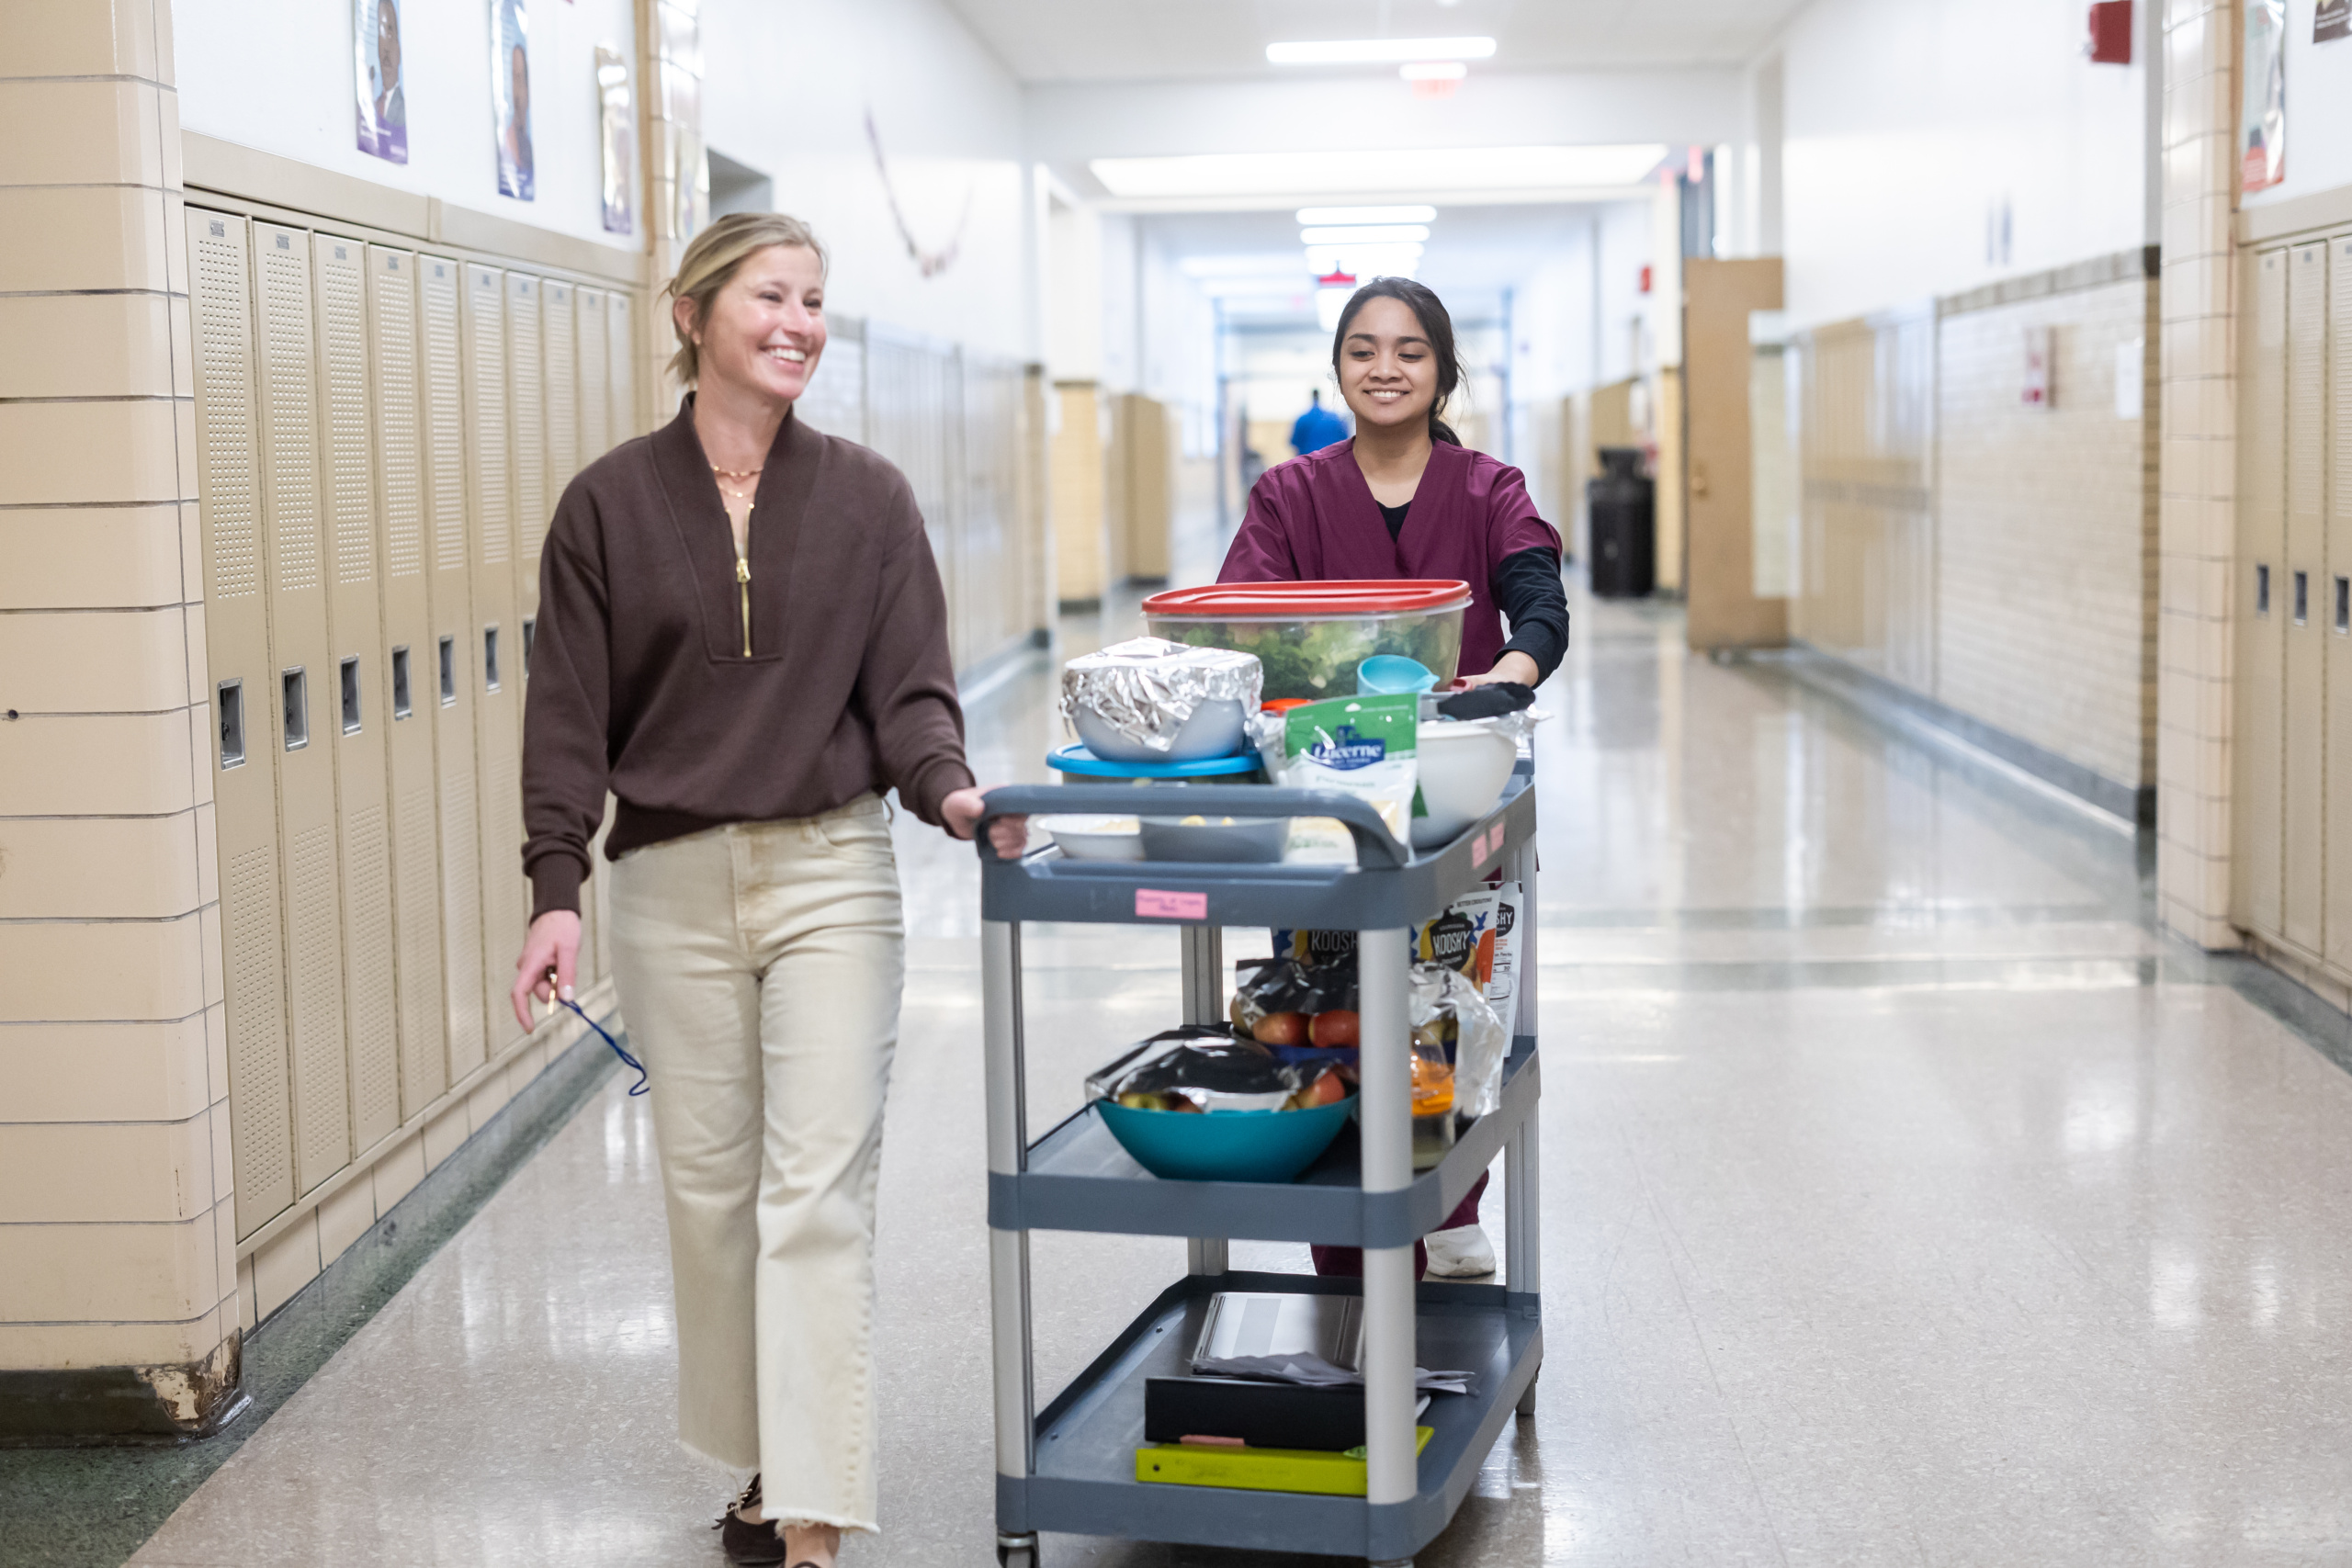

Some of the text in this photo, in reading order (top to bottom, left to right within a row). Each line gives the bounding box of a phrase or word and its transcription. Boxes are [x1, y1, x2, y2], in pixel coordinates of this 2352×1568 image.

[1496, 911, 1513, 925] SHY
[1311, 931, 1358, 952] KOOSH
[1433, 931, 1471, 956] KOOSHY
